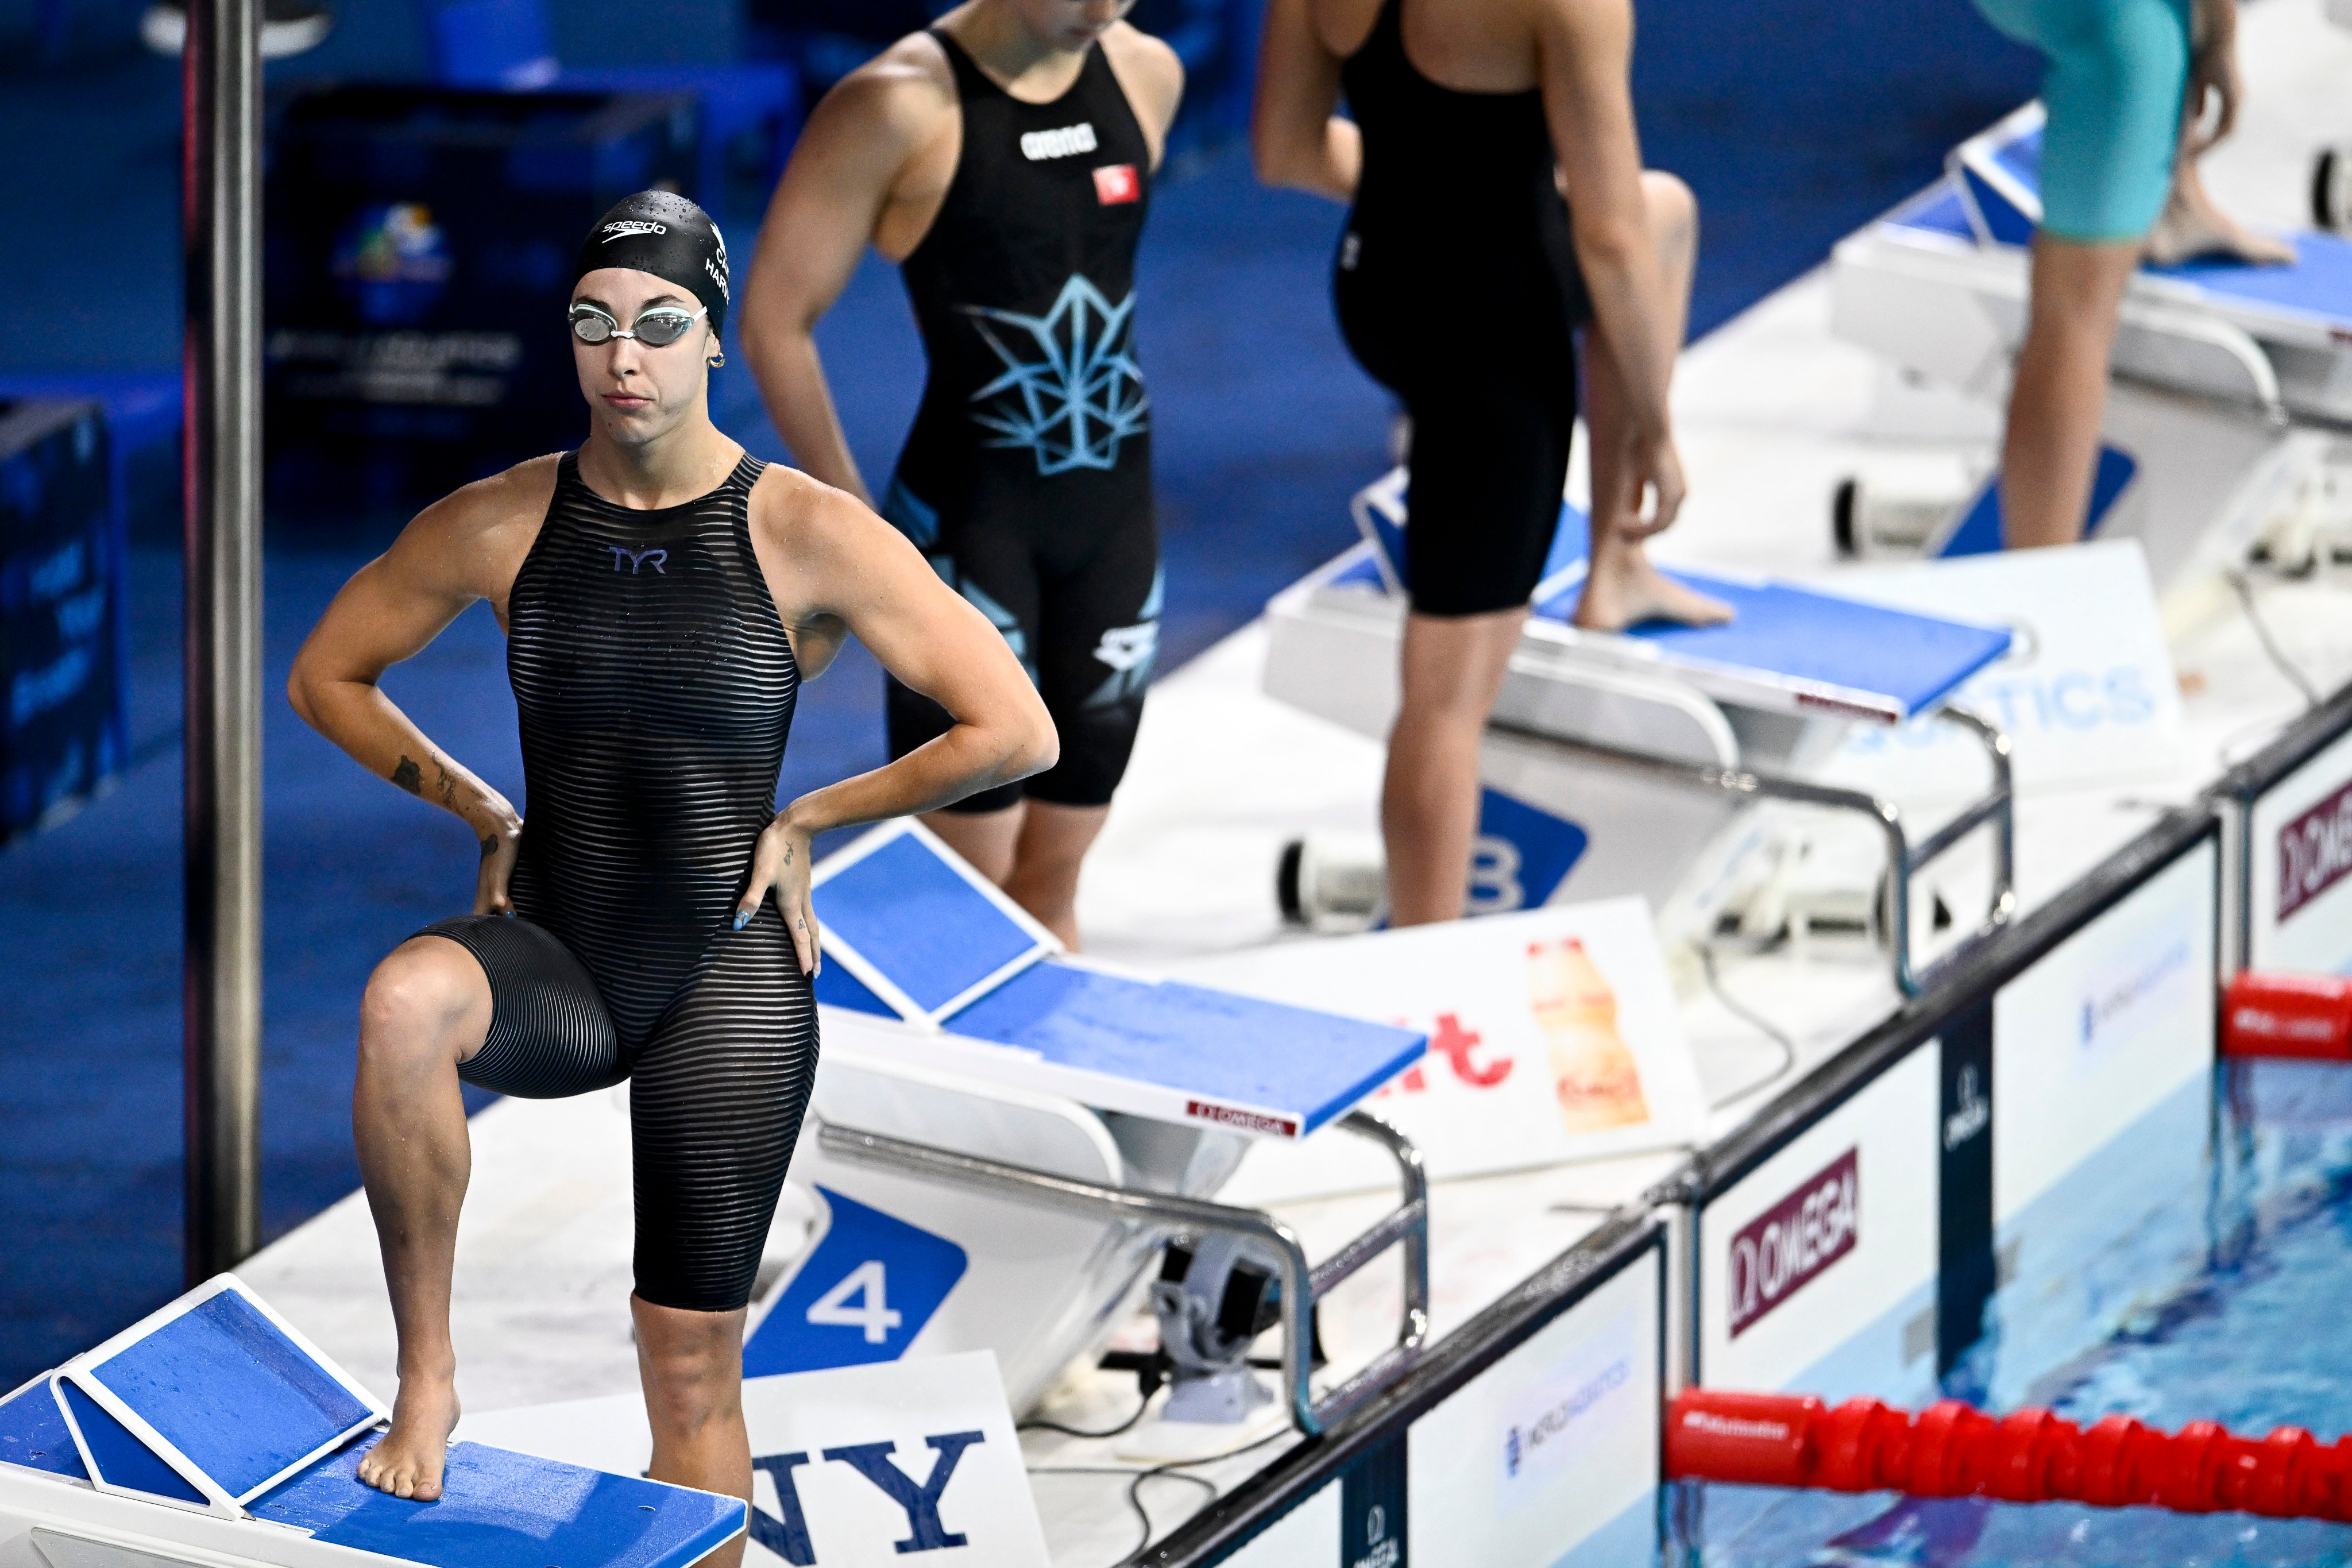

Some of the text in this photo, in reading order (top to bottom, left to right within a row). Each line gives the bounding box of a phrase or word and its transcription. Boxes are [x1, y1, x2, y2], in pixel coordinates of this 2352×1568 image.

[602, 221, 666, 235] speedo
[609, 546, 668, 574] TYR
[1758, 1169, 1856, 1299] OMEGA
[806, 1260, 902, 1345] 4
